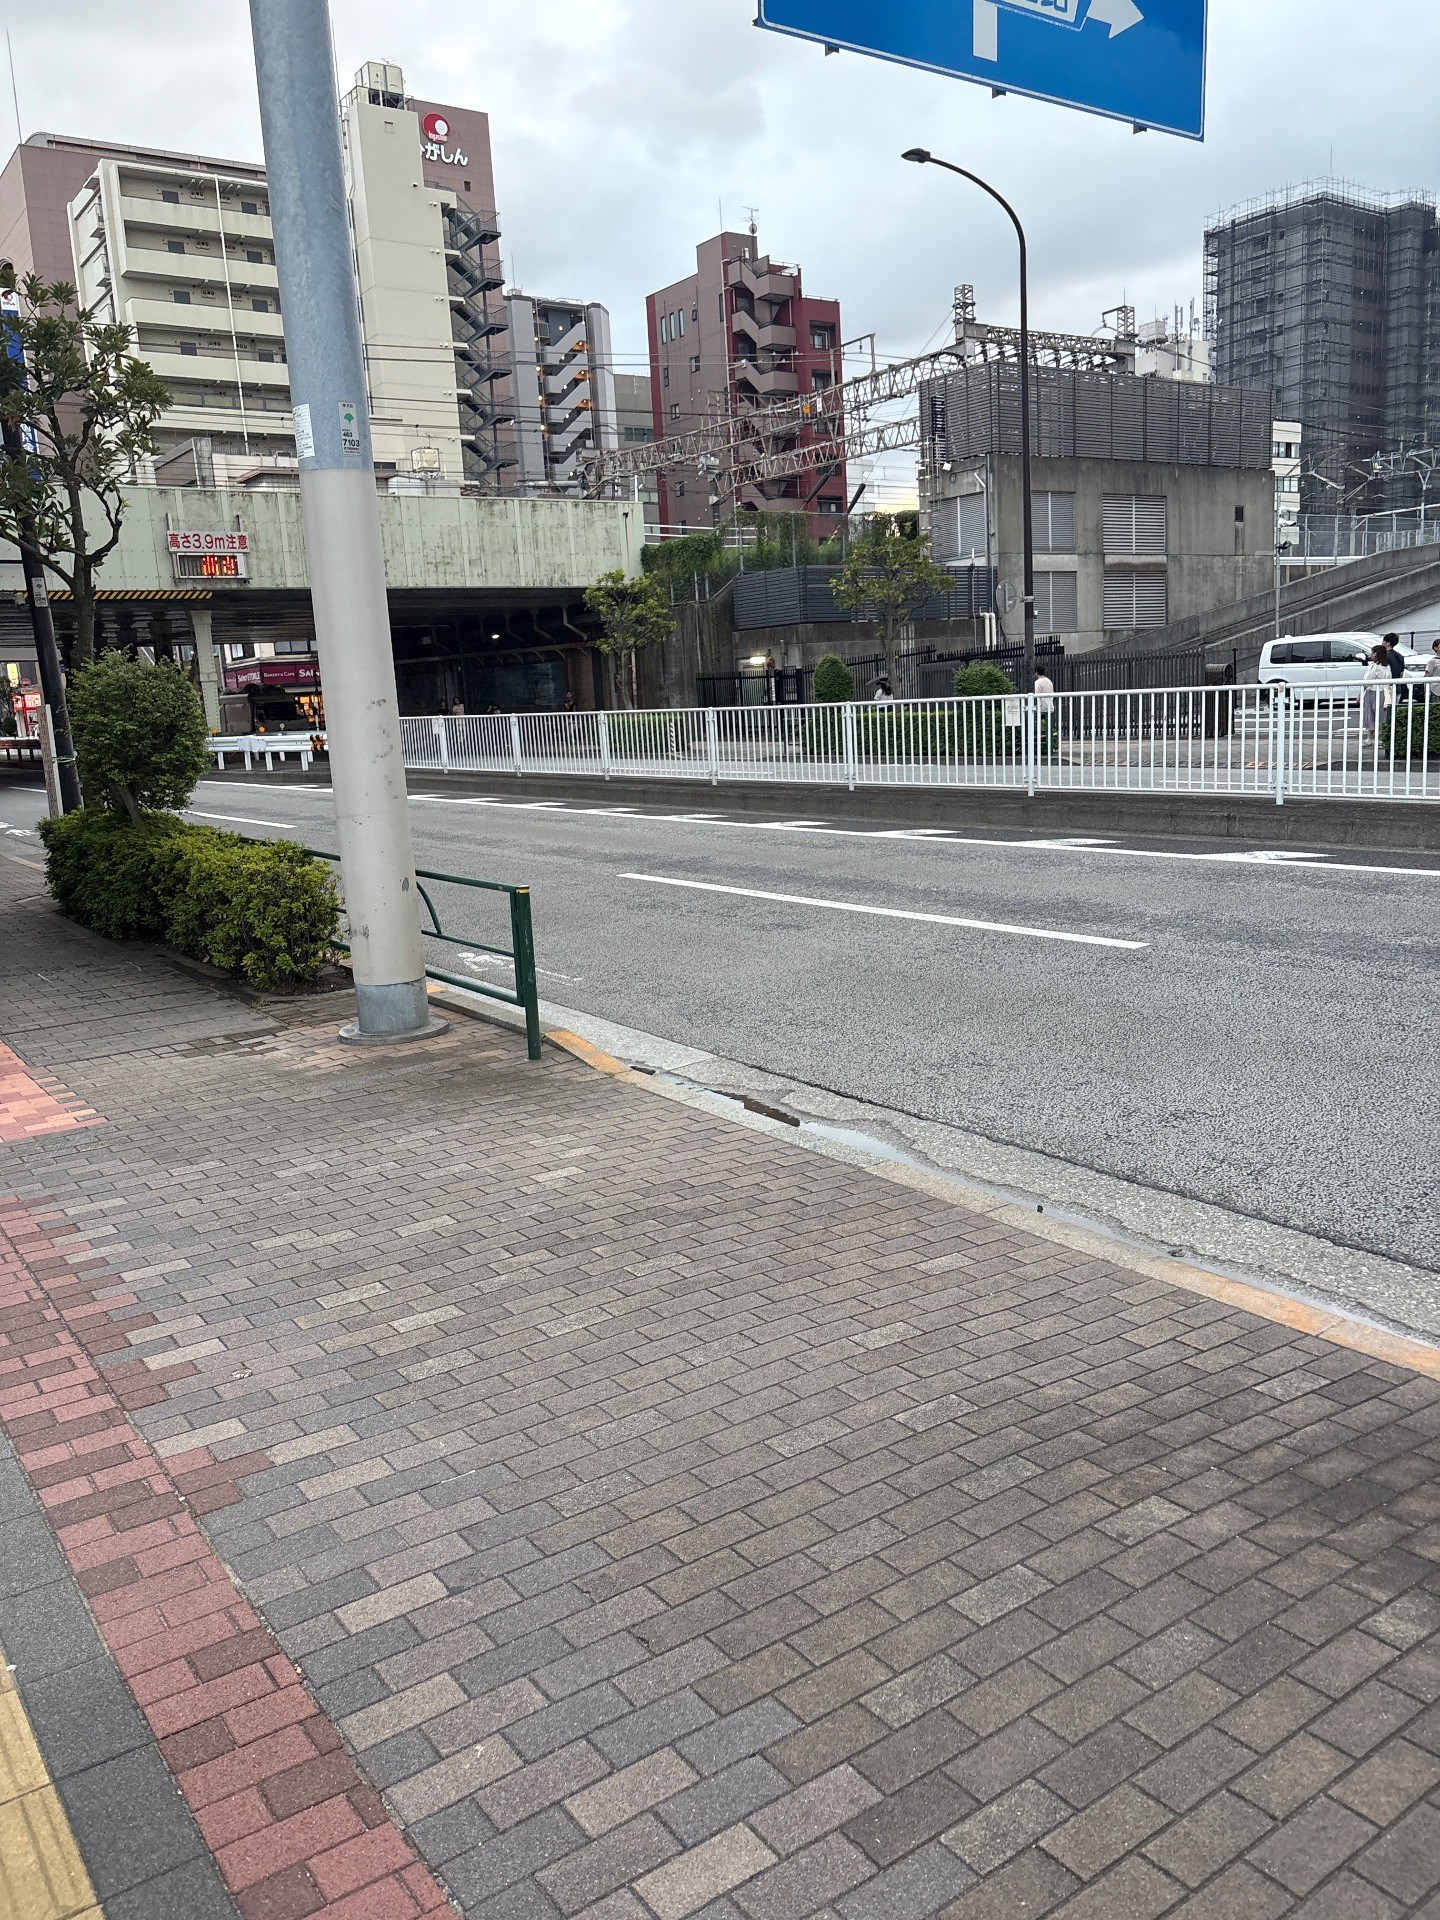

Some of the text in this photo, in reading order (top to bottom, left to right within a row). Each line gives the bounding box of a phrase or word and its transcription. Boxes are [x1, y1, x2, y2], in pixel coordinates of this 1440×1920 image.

[342, 439, 360, 447] 7103
[168, 532, 249, 550] 高さ3.9m注意
